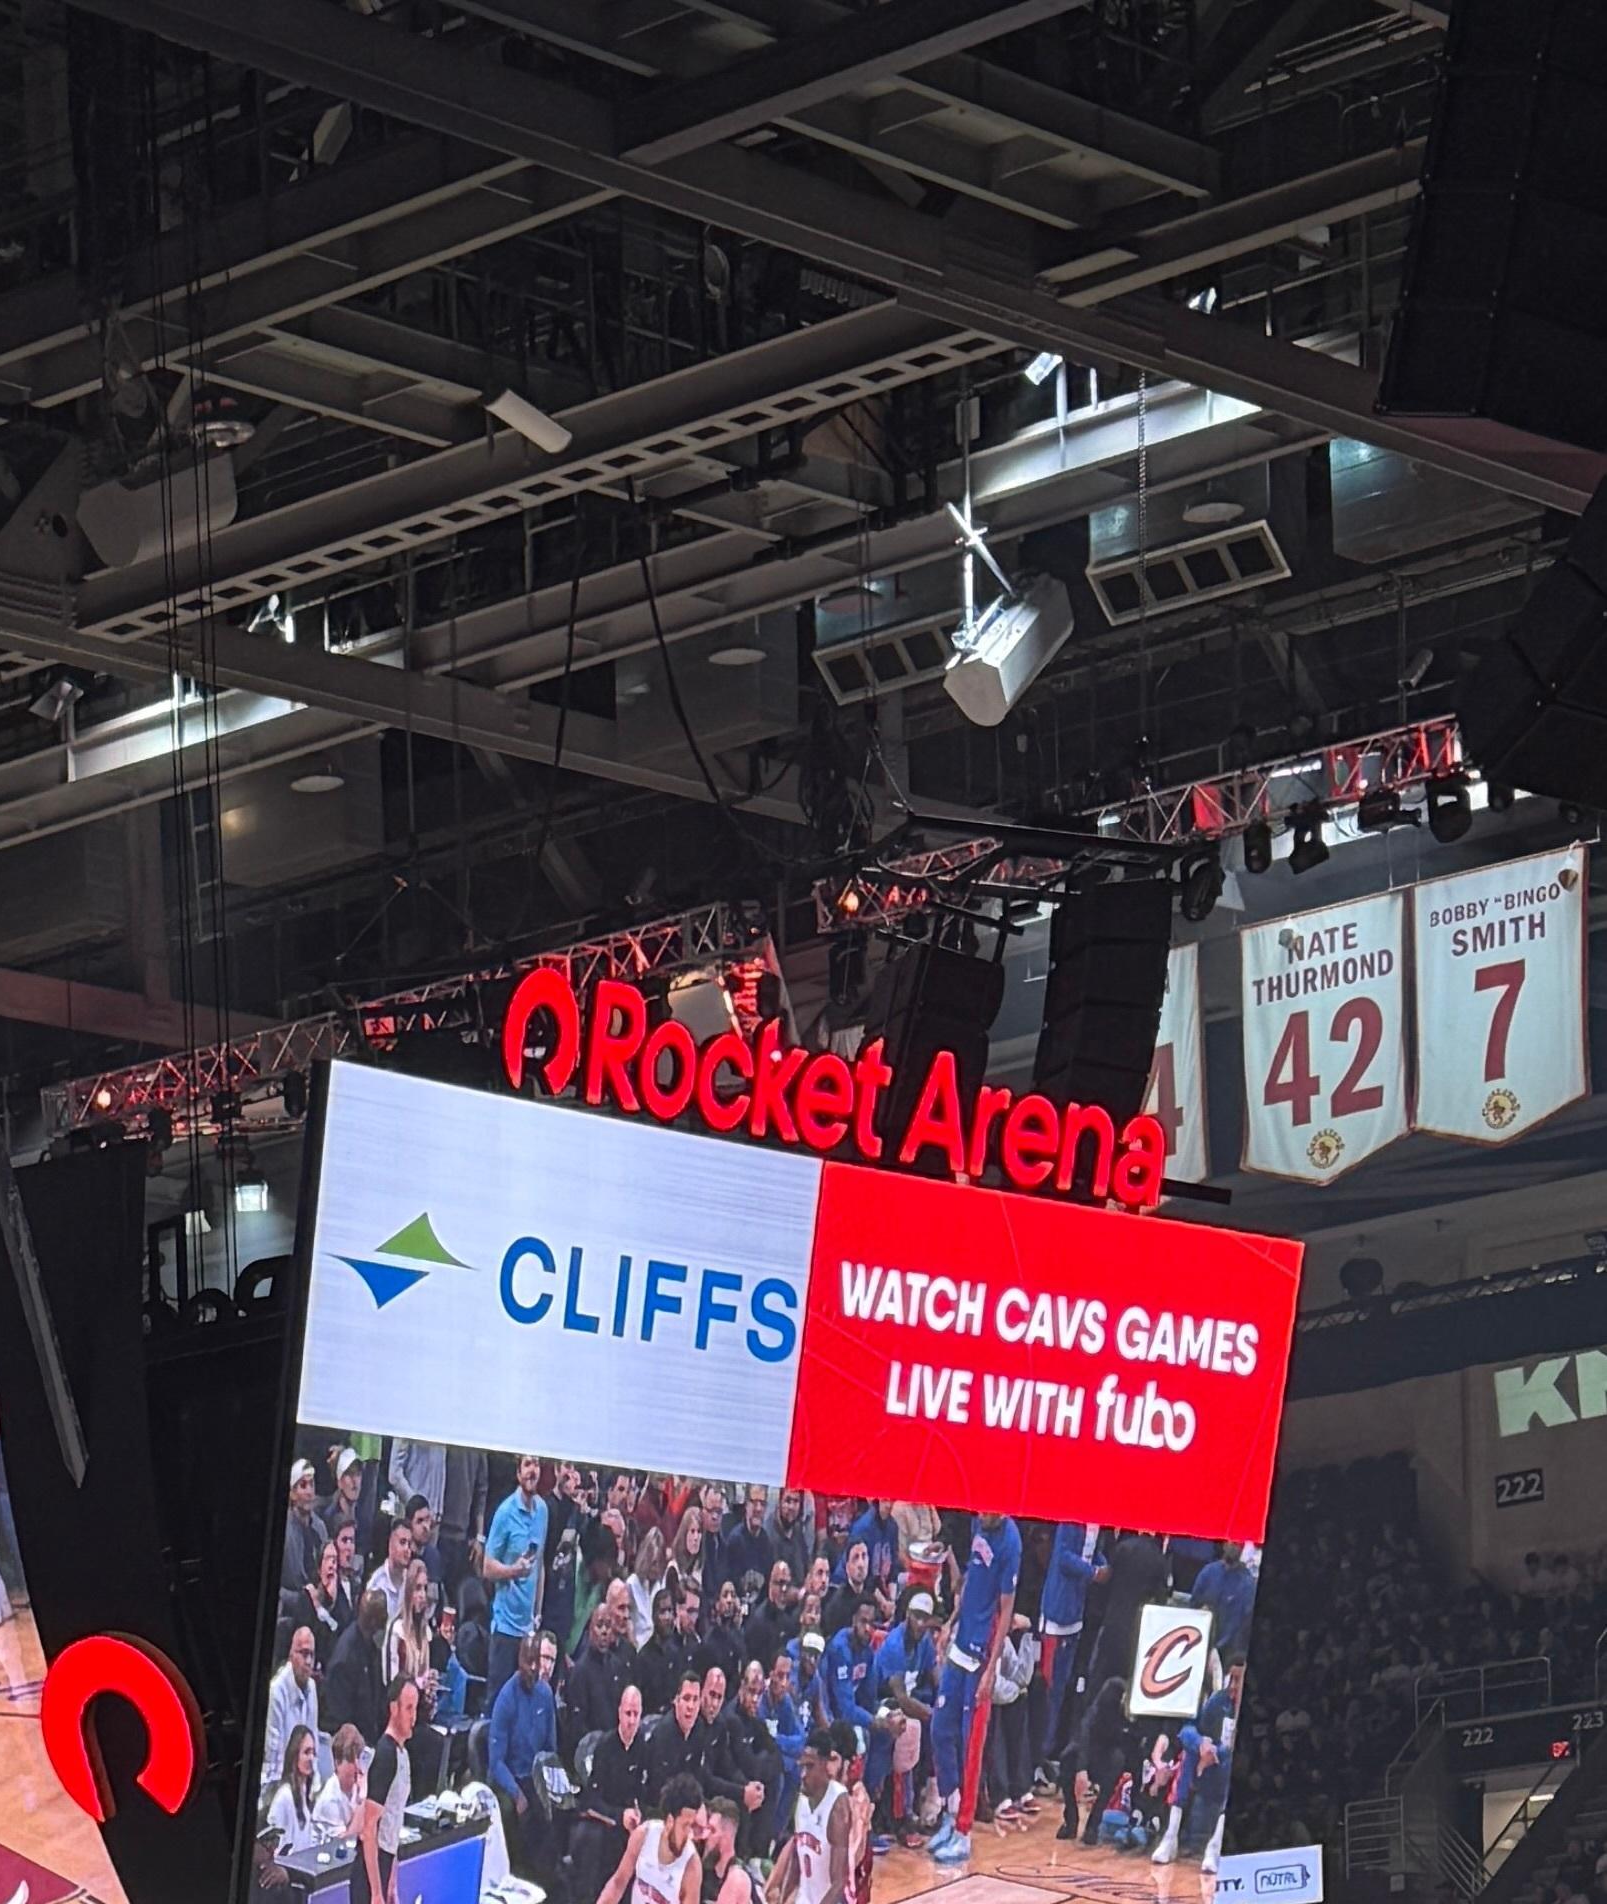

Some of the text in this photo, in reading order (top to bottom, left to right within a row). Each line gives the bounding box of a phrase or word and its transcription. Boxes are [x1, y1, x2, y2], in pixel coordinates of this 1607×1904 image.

[1288, 922, 1358, 965] NATE
[1430, 898, 1489, 928] BOBBY
[1451, 912, 1546, 956] SMITH
[1252, 948, 1393, 1006] THURMOND
[1475, 959, 1525, 1083] 7
[584, 978, 1168, 1206] Rocket Arena
[1263, 996, 1384, 1127] 42
[497, 1235, 796, 1365] CLIFFS
[839, 1261, 1260, 1377] WATCH CAVS GAMES
[885, 1360, 1196, 1453] LIVE WITH fubo
[1497, 1473, 1542, 1501] 222
[1463, 1728, 1493, 1746] 222
